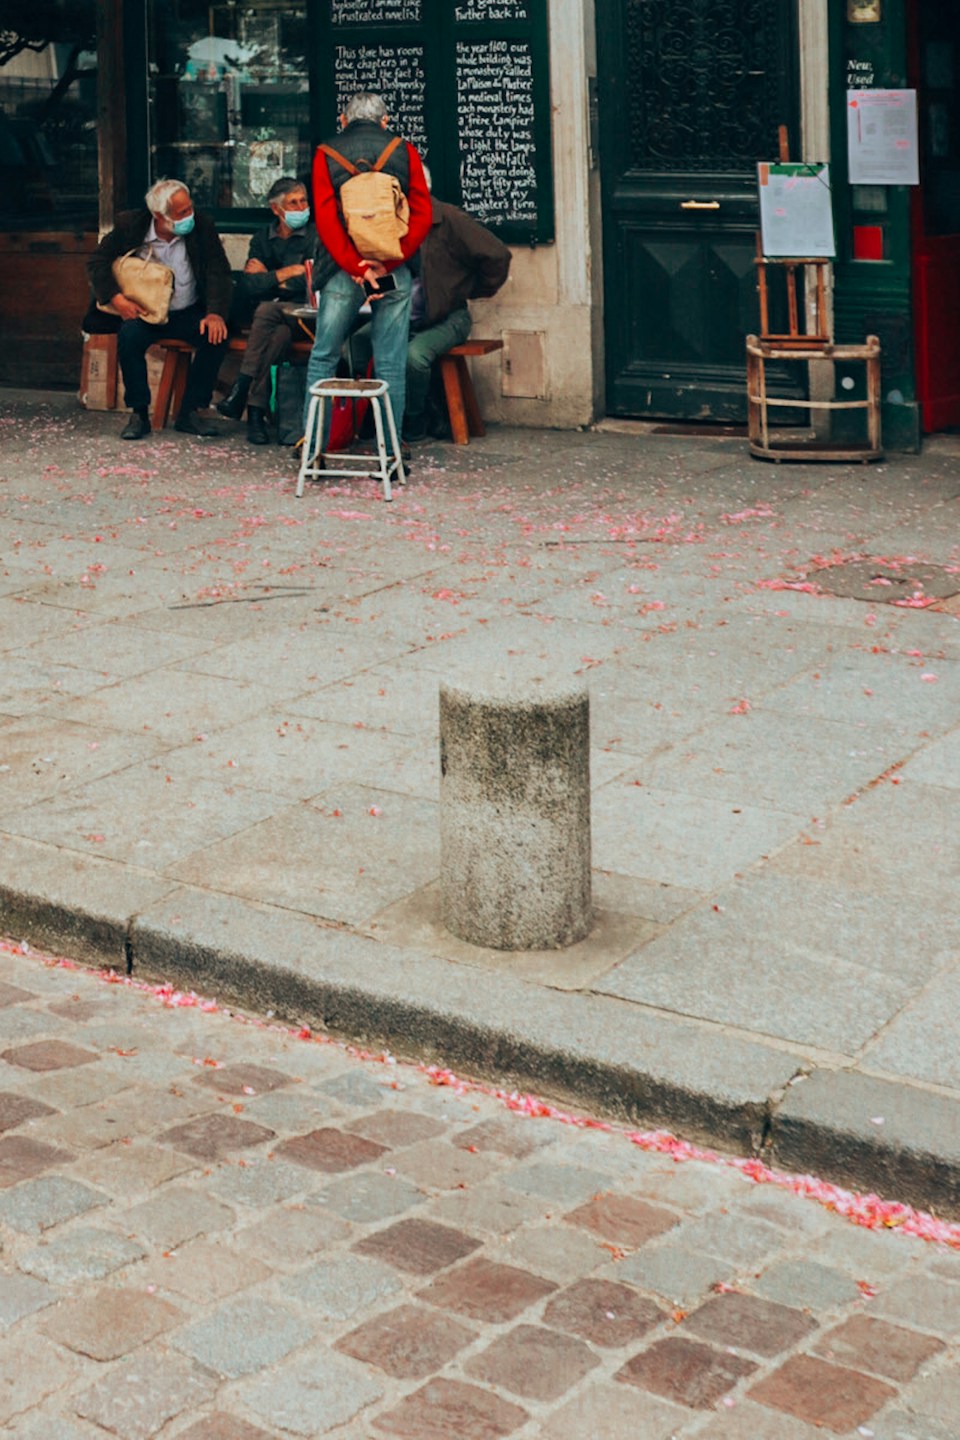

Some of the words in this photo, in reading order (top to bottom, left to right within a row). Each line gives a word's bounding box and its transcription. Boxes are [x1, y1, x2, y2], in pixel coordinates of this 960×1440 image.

[455, 7, 486, 21] Further
[489, 6, 512, 19] back
[515, 6, 526, 18] in
[336, 46, 356, 59] This
[379, 44, 394, 56] has
[397, 47, 423, 56] rooms
[457, 42, 469, 53] the
[471, 44, 488, 55] year
[511, 44, 528, 52] our
[357, 59, 397, 70] chapters
[400, 57, 408, 66] in
[479, 54, 512, 66] building
[513, 56, 532, 64] was
[336, 70, 358, 79] novel
[361, 70, 377, 79] and
[380, 69, 392, 78] the
[395, 68, 411, 78] fact
[416, 68, 424, 77] is
[463, 65, 503, 79] monastery
[505, 65, 531, 76] called
[367, 79, 380, 90] and
[847, 74, 874, 85] Used
[401, 91, 409, 101] to
[458, 92, 466, 102] In
[506, 91, 532, 102] times
[458, 103, 475, 113] each
[477, 103, 516, 117] monastery
[519, 104, 534, 114] had
[408, 124, 424, 132] the
[458, 126, 483, 137] whose
[486, 126, 509, 139] duty
[513, 131, 531, 139] was
[459, 139, 468, 150] to
[470, 139, 491, 155] light
[495, 139, 508, 150] the
[466, 152, 476, 163] at
[466, 165, 486, 177] have
[488, 166, 507, 176] been
[508, 166, 535, 179] doing
[461, 178, 479, 188] this
[462, 190, 482, 199] Now
[485, 188, 492, 198] it
[510, 190, 528, 200] my
